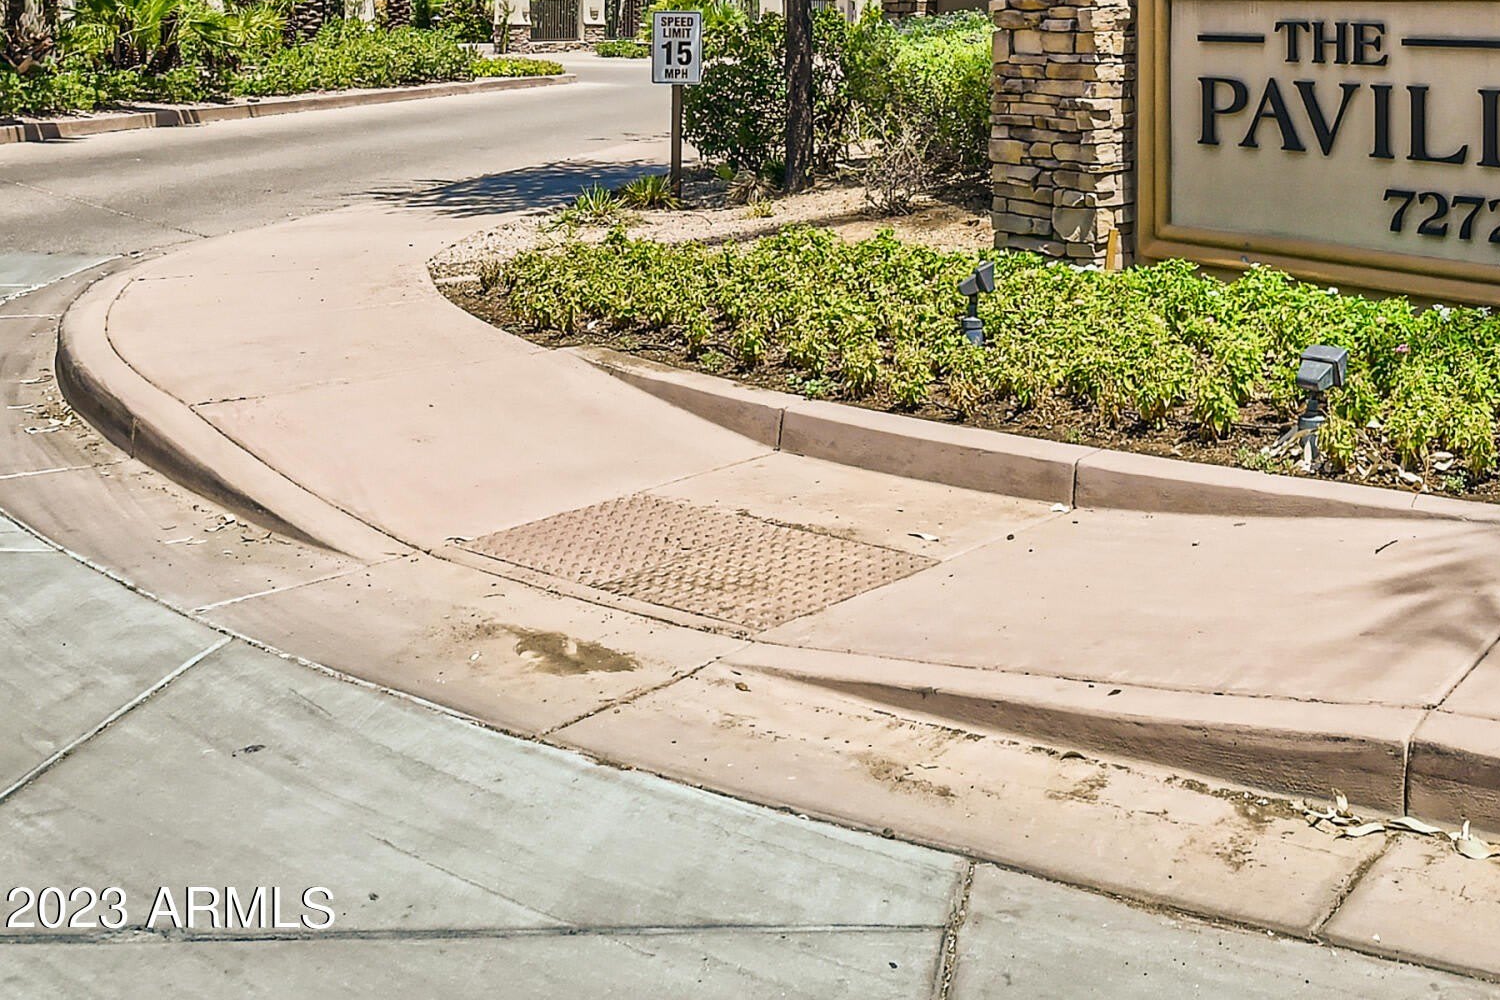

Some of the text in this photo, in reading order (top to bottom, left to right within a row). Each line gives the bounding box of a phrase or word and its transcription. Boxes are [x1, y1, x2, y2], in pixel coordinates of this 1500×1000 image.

[661, 16, 694, 27] SPEED
[663, 28, 692, 38] LIMIT
[1274, 20, 1389, 67] THE
[661, 41, 692, 66] 15
[664, 68, 688, 79] MPH
